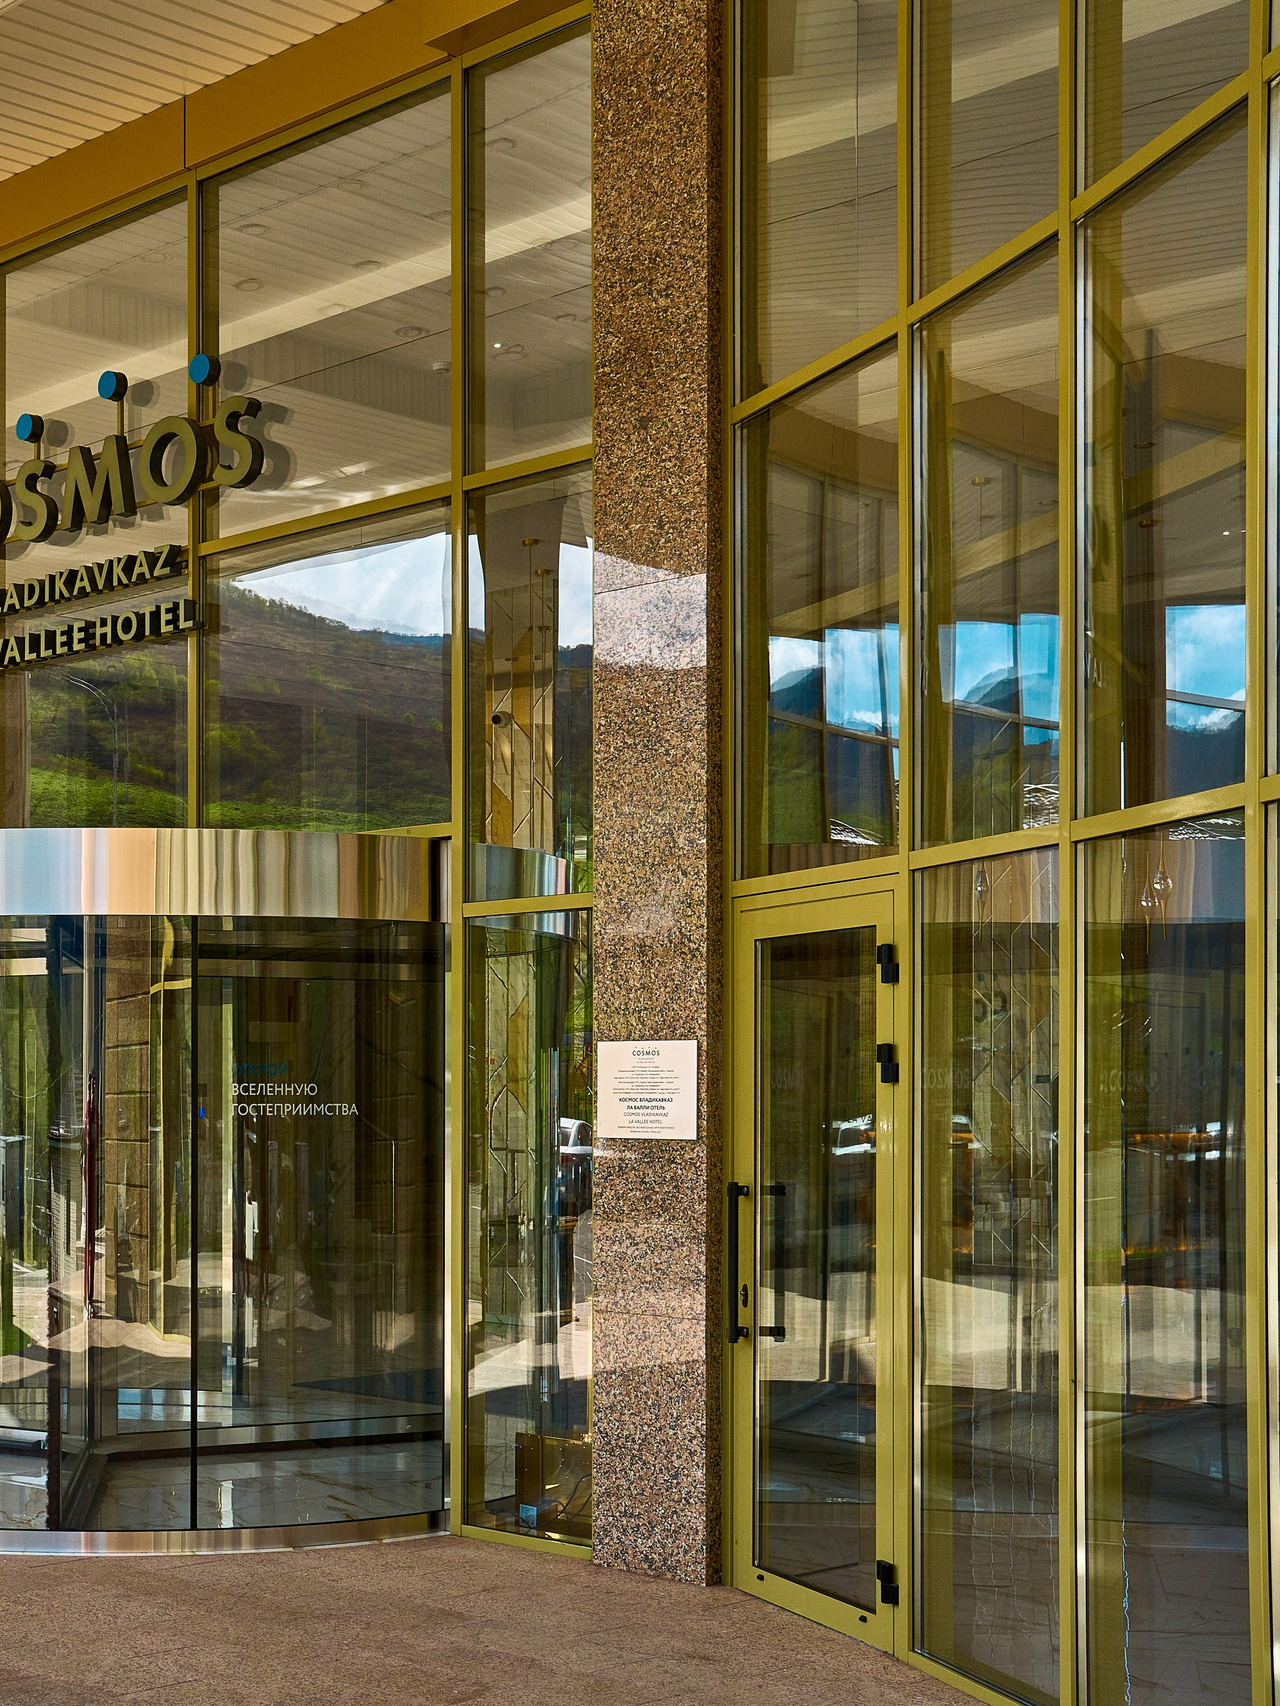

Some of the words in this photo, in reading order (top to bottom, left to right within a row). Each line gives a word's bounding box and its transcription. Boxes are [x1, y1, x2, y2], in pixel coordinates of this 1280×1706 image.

[95, 599, 195, 646] HOTEL
[231, 1061, 288, 1076] ОТКРОЙ
[231, 1083, 318, 1096] ВСЕЛЕННУЮ
[231, 1103, 359, 1116] ГОСТЕПРИИМСТВА
